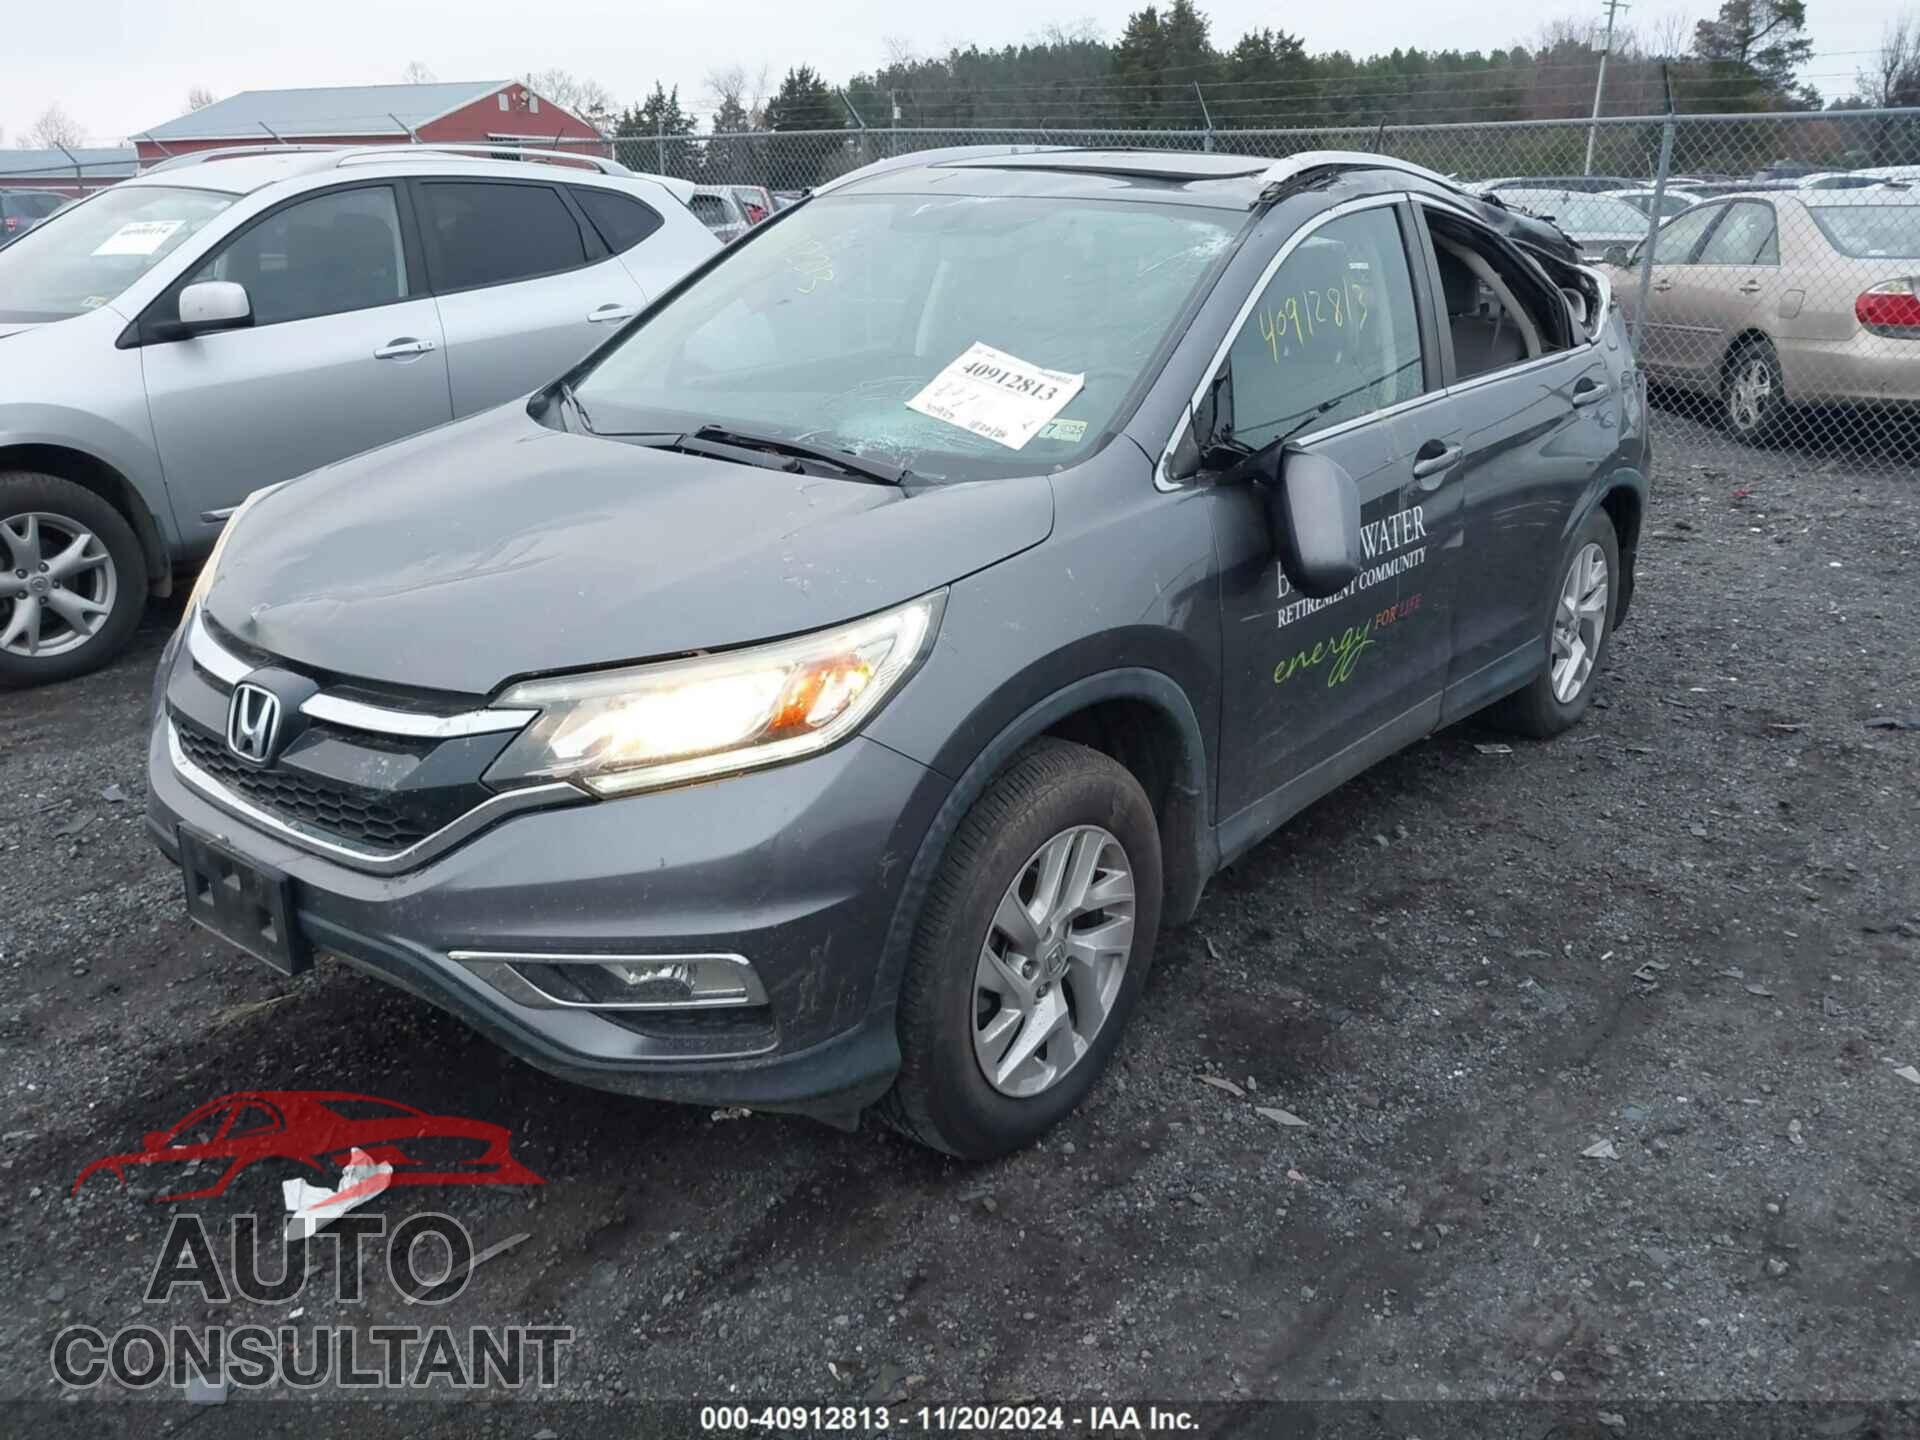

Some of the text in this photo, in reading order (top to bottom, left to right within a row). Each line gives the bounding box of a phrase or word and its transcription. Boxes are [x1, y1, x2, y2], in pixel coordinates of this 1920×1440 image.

[1258, 278, 1368, 364] 40912813
[963, 362, 1058, 401] 40912813
[1359, 546, 1427, 590] COMMUNITY
[1274, 618, 1375, 688] energy
[1375, 604, 1399, 630] FOR
